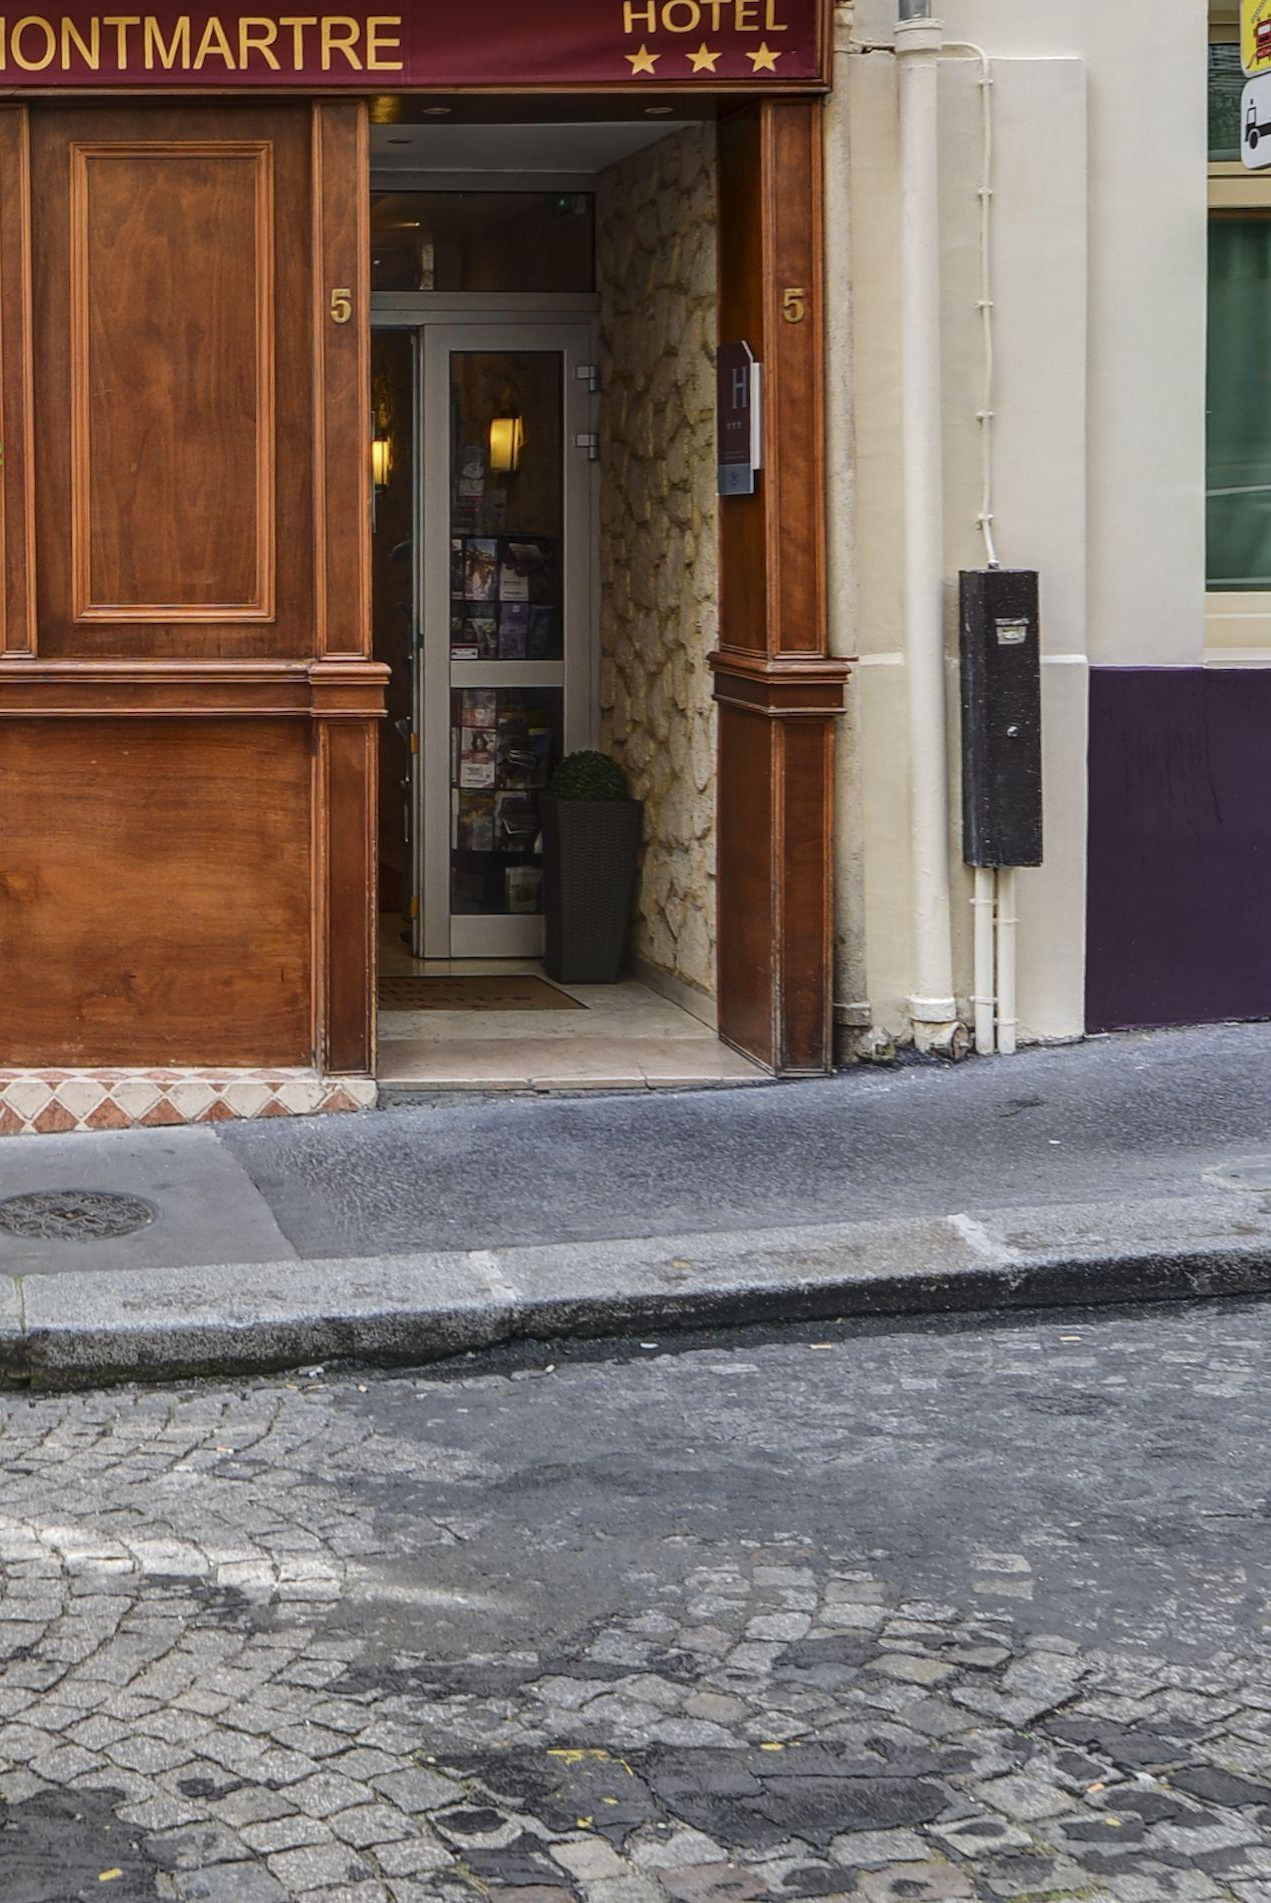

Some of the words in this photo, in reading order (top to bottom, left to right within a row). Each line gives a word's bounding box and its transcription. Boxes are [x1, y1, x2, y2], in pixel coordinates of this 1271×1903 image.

[330, 288, 352, 324] 5
[783, 287, 805, 323] 5
[731, 366, 748, 410] H
